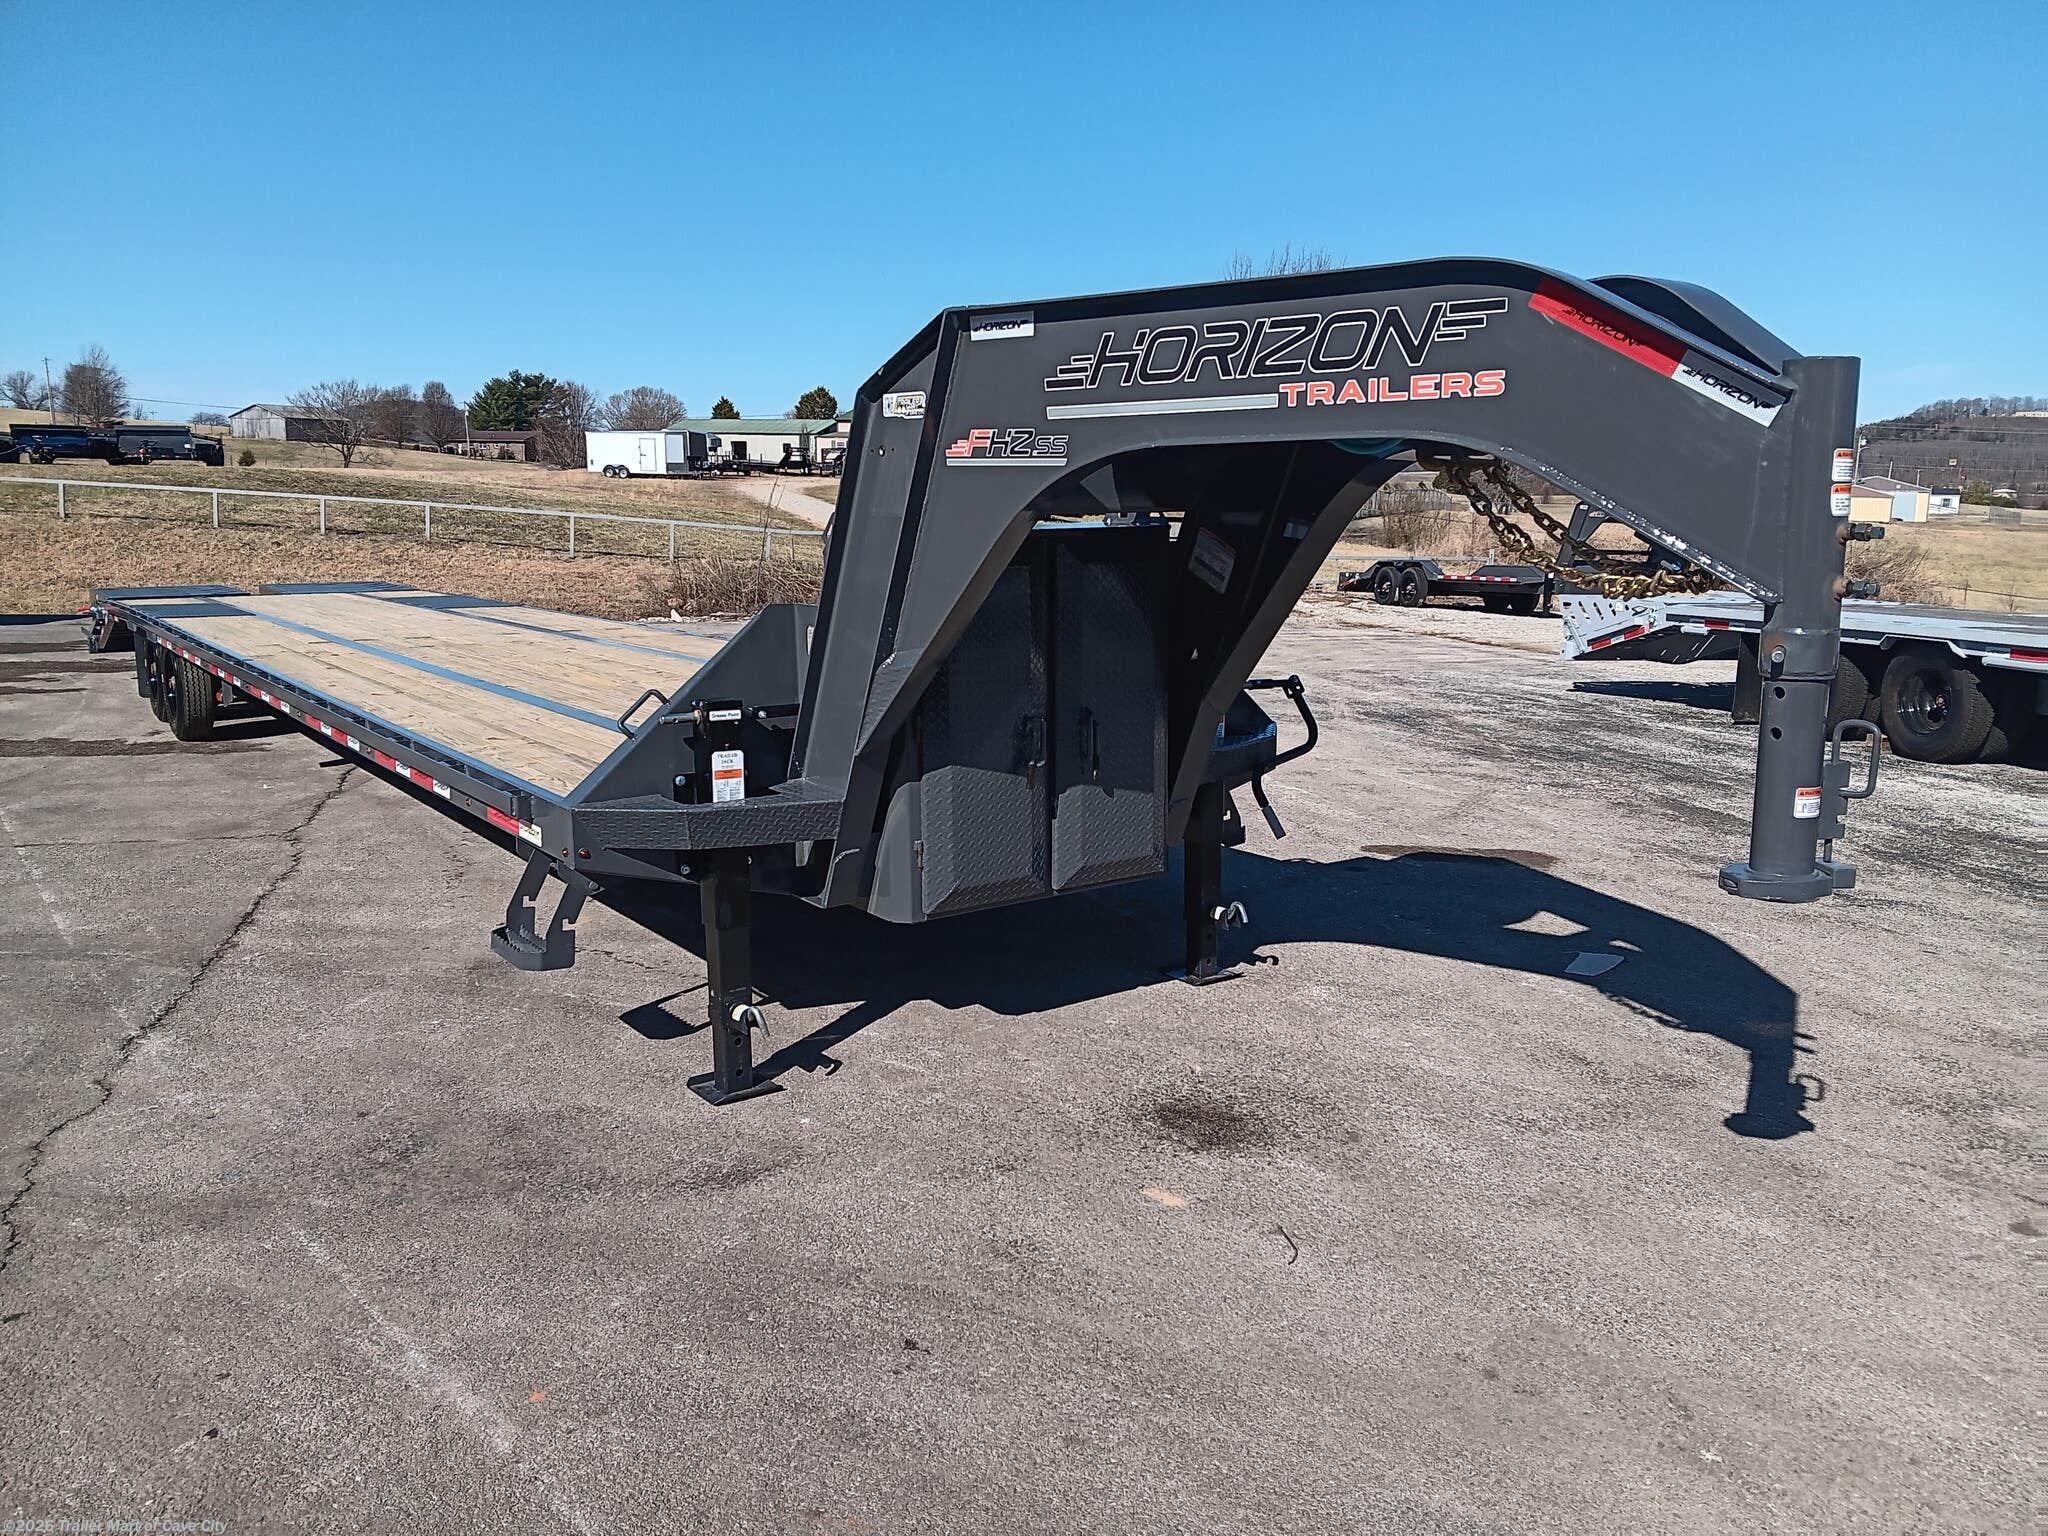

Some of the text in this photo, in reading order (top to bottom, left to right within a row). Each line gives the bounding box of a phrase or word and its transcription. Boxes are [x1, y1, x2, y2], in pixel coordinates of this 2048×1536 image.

[977, 319, 1022, 332] HORIZON
[1084, 301, 1447, 390] HORIZON
[1571, 307, 1642, 347] HORIZON
[1279, 369, 1507, 408] TRAILERS
[1692, 367, 1767, 410] HORIZON
